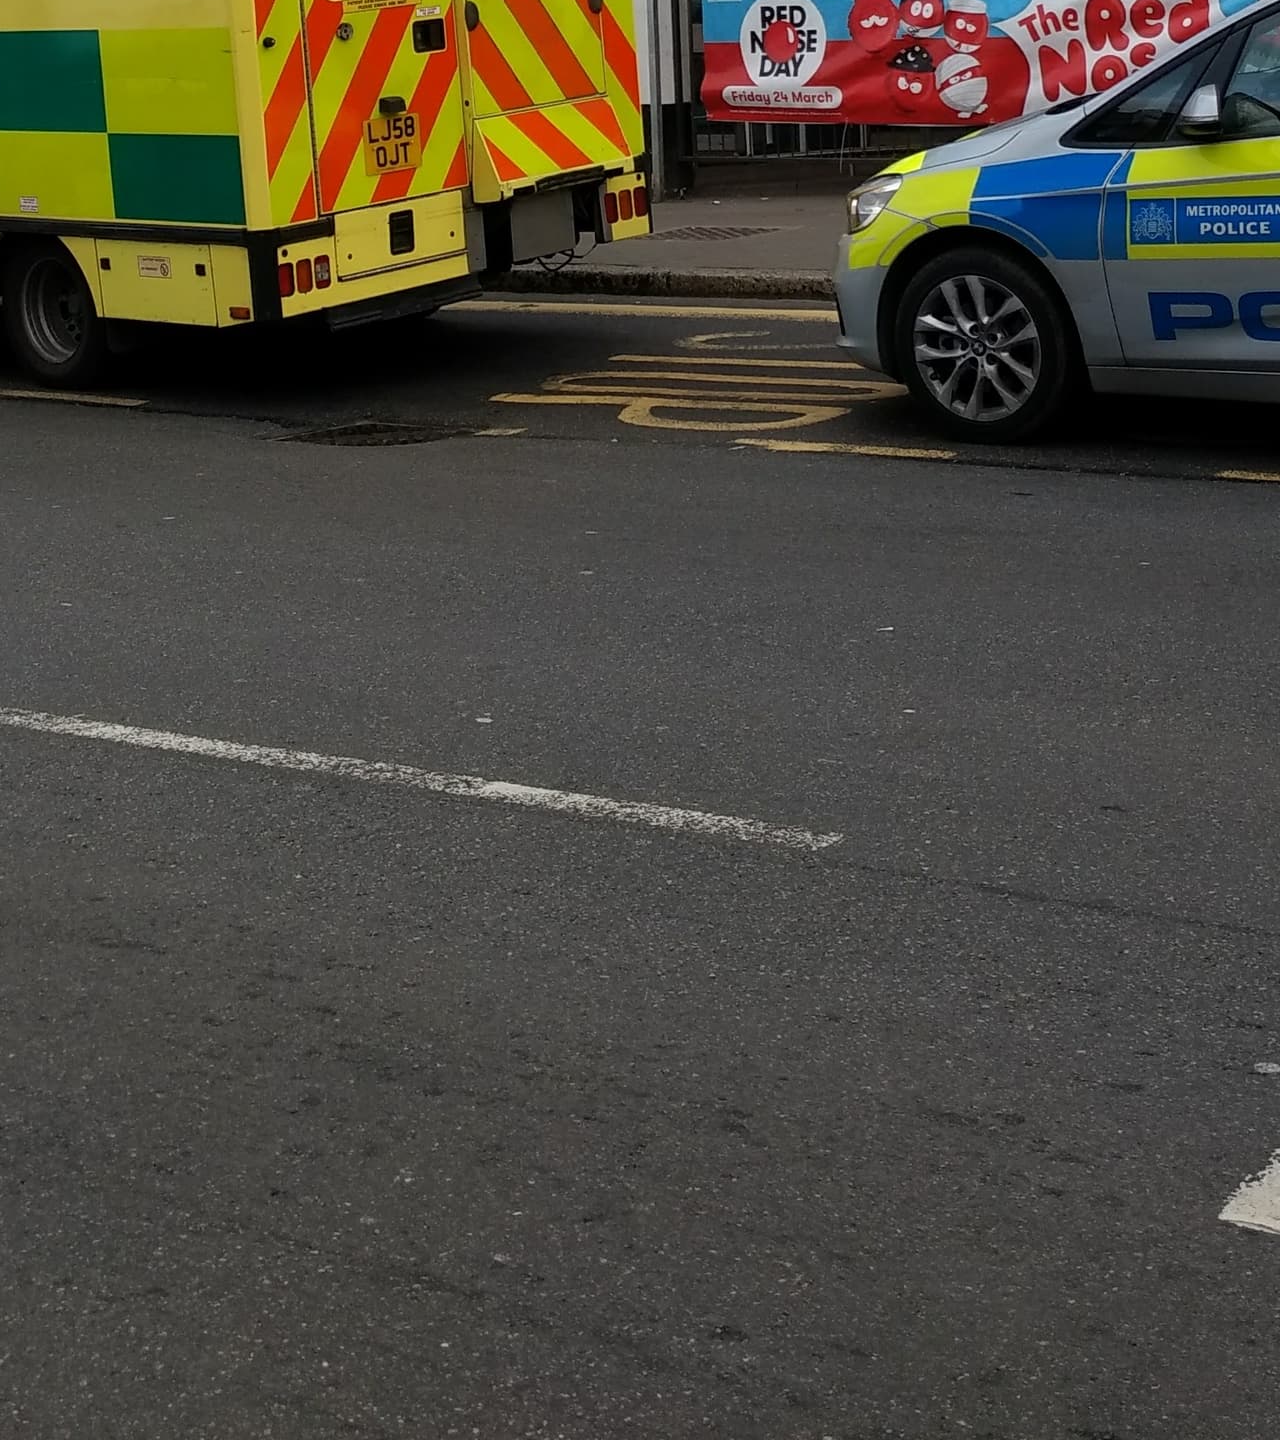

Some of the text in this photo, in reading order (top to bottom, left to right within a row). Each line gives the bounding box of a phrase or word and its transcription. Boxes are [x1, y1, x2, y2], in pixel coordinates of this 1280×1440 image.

[760, 5, 806, 29] RED
[1018, 4, 1080, 43] The
[758, 55, 803, 78] DAY
[1038, 38, 1157, 103] Nos
[730, 90, 833, 105] Friday 24 March
[368, 115, 415, 145] LJ58
[375, 143, 411, 169] OJT
[1199, 221, 1271, 236] POLICE
